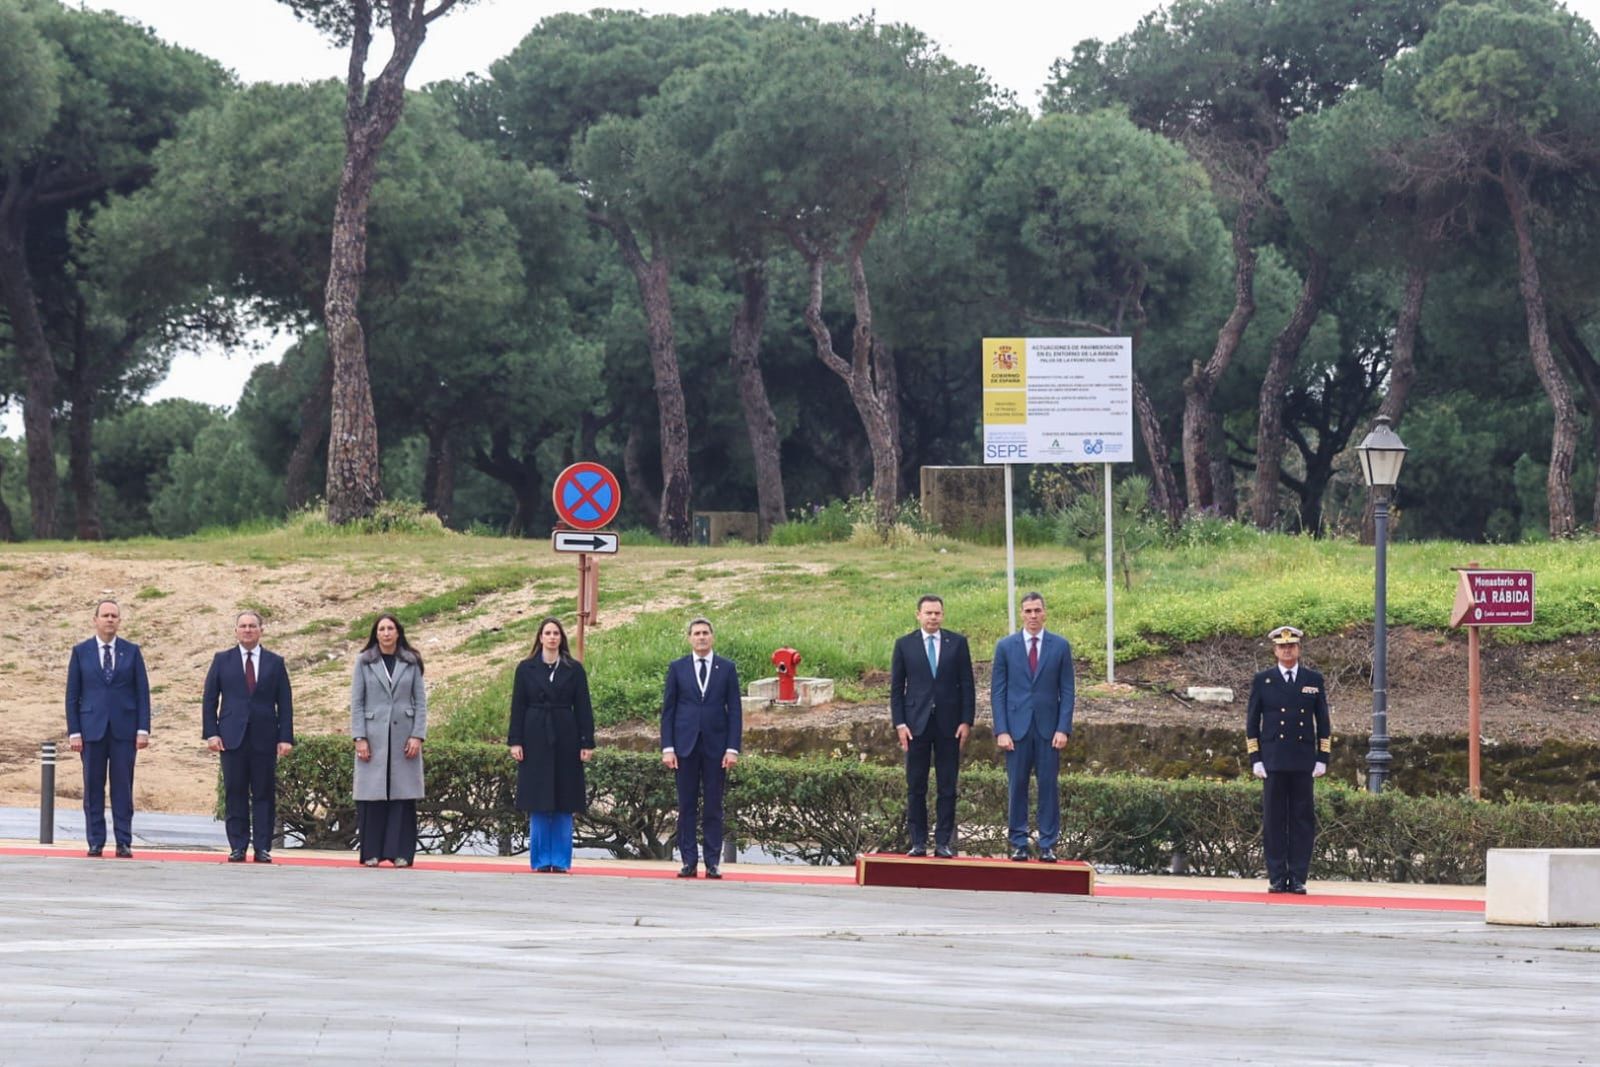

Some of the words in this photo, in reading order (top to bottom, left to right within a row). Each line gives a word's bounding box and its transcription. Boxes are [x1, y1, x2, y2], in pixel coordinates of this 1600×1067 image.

[987, 444, 1028, 458] SEPE
[1475, 576, 1515, 587] Monasterio
[1518, 577, 1528, 587] de
[1474, 591, 1487, 603] LA
[1492, 588, 1530, 604] RÁBIDA
